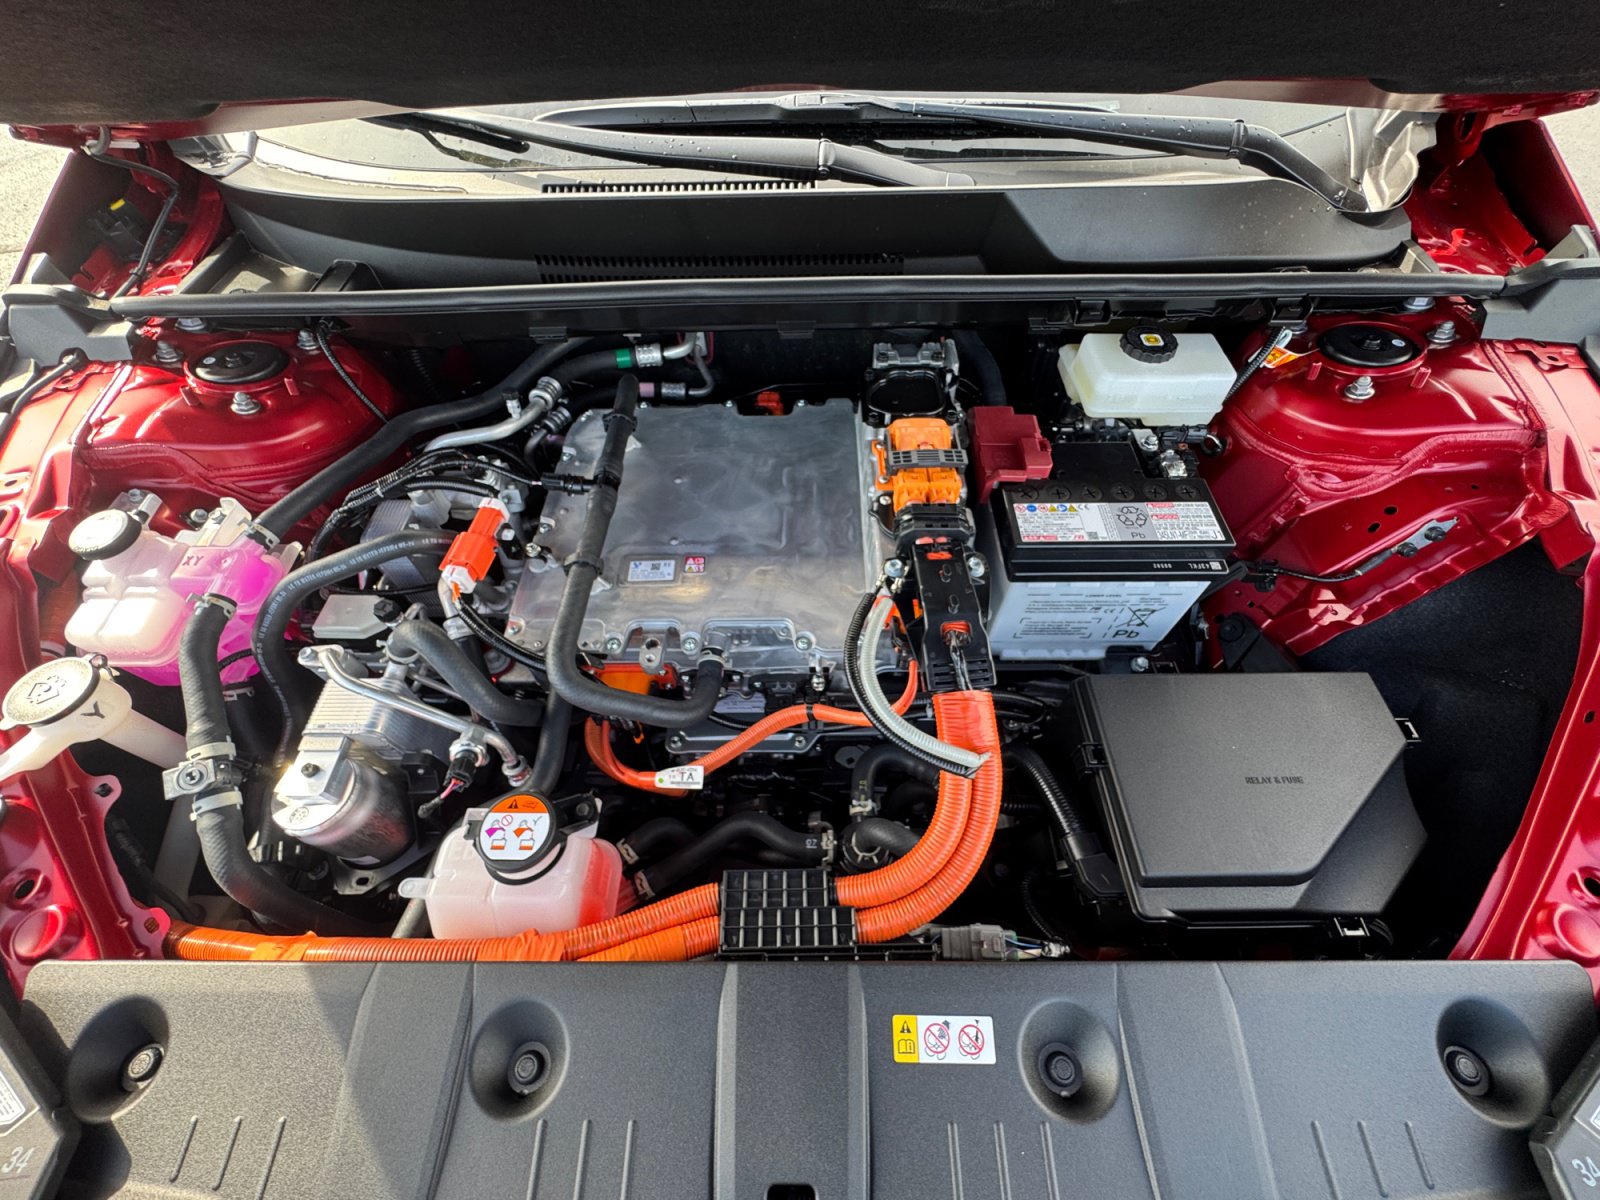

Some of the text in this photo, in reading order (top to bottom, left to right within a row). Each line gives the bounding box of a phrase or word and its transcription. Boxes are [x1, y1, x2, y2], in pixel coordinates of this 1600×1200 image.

[1131, 531, 1146, 539] Pb
[1112, 629, 1139, 639] Pb
[679, 771, 694, 781] TA
[1244, 776, 1271, 784] RELAY
[1281, 776, 1304, 784] FUSE
[1, 1146, 35, 1174] 34
